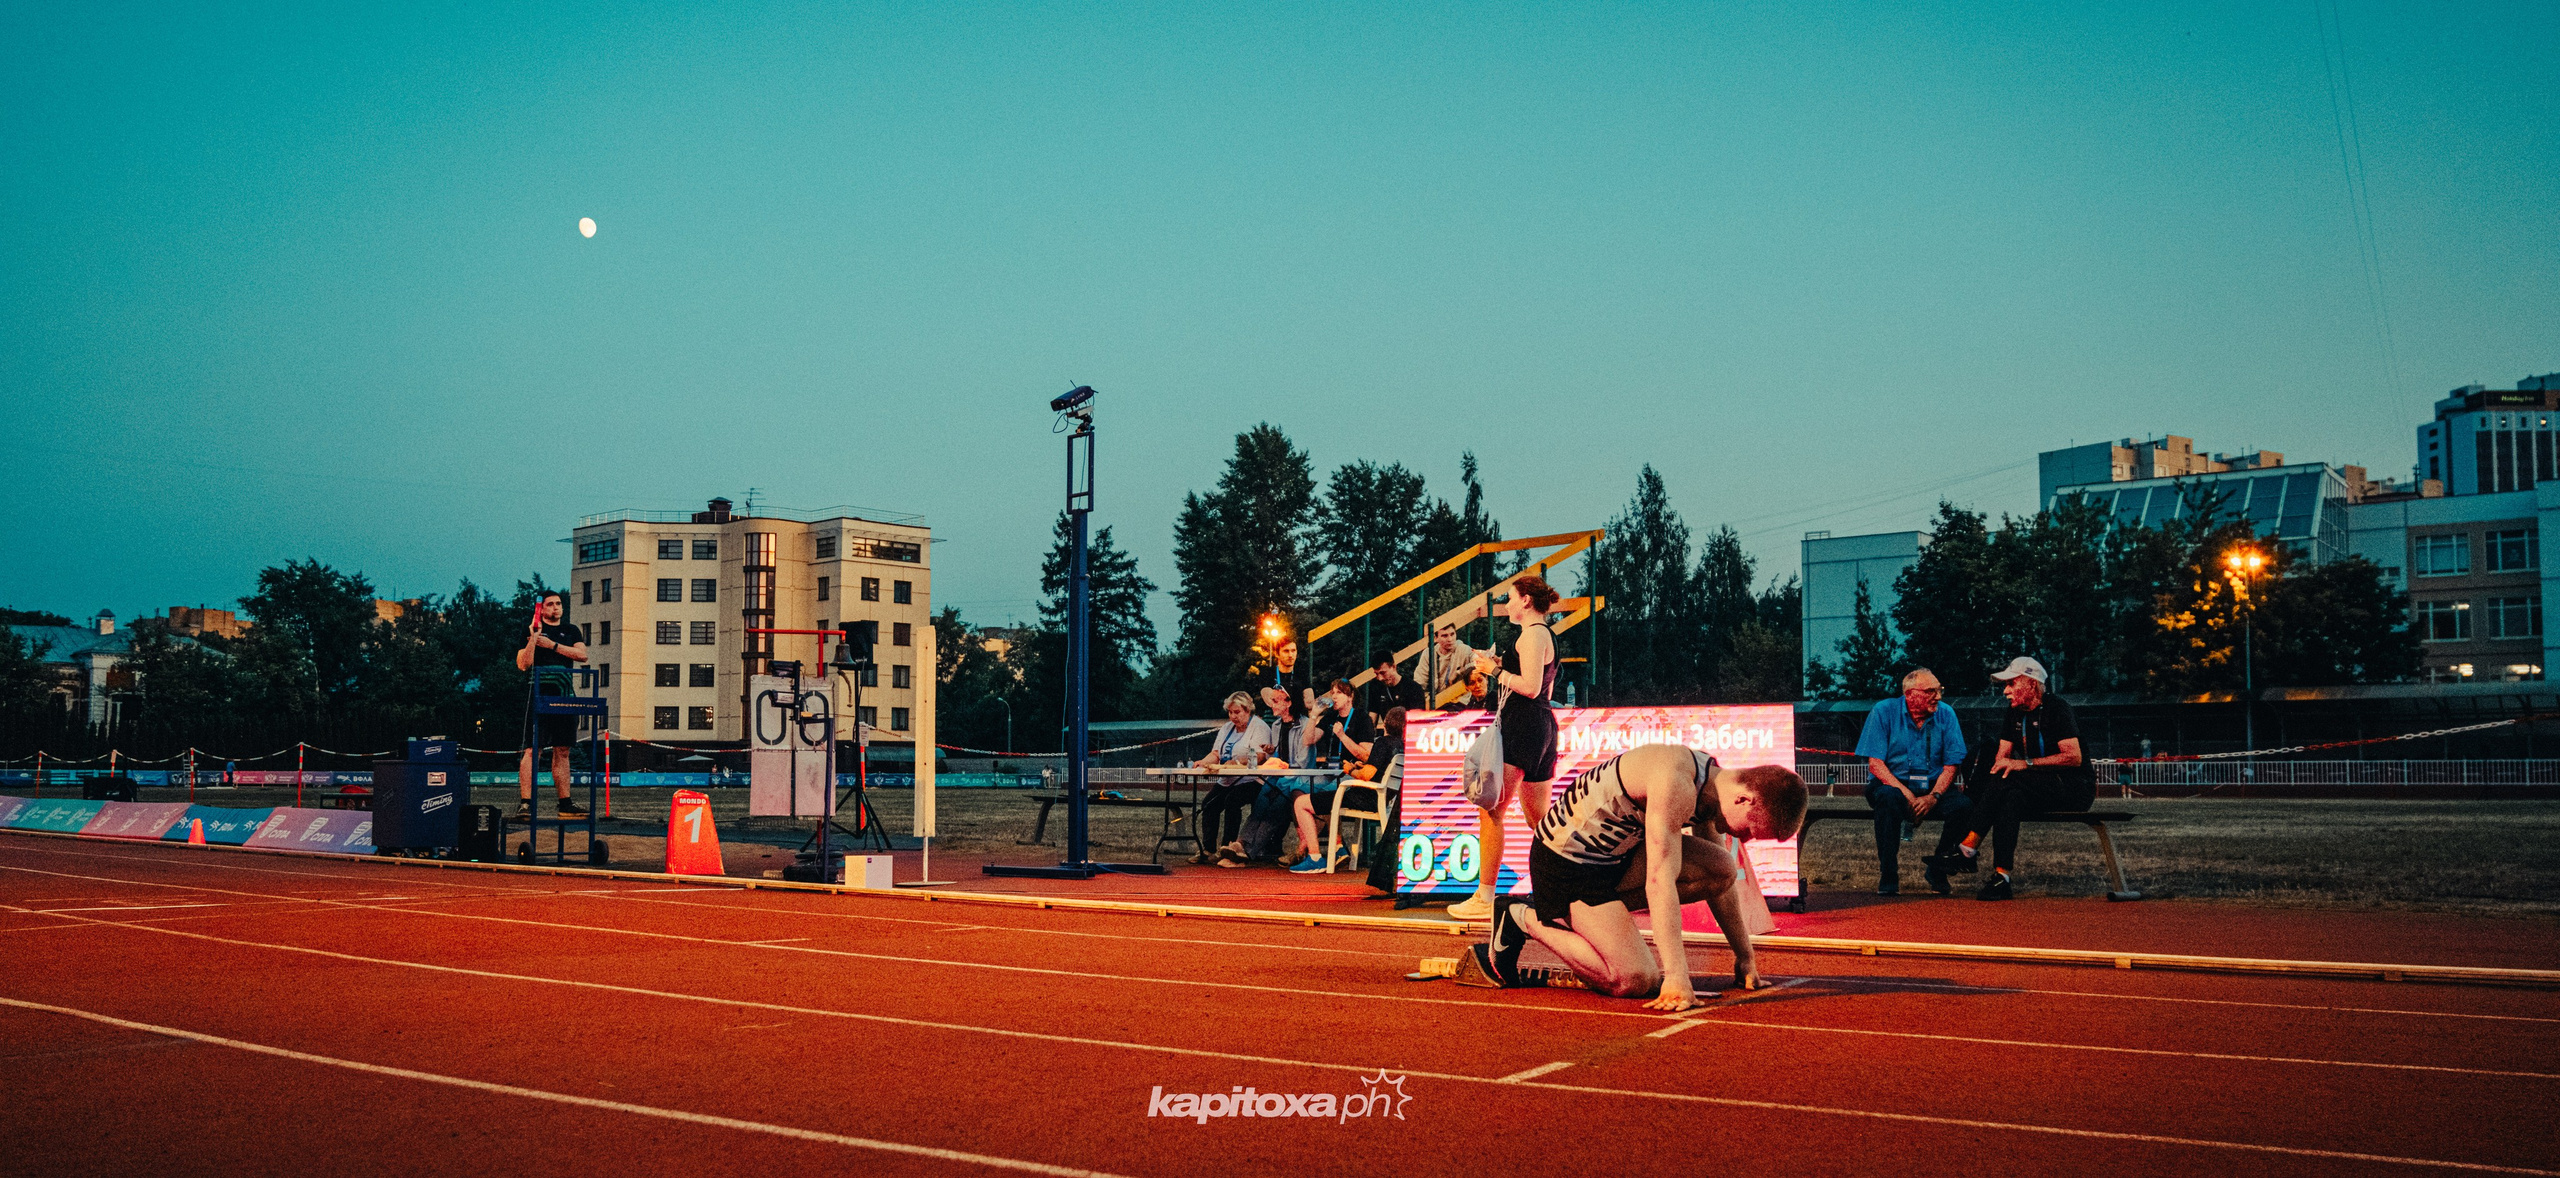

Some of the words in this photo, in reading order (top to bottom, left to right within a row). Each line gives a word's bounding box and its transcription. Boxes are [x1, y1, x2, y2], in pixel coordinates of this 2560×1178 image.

[1570, 725, 1683, 758] Мужчины
[1689, 723, 1774, 750] Забеги
[684, 807, 703, 843] 1
